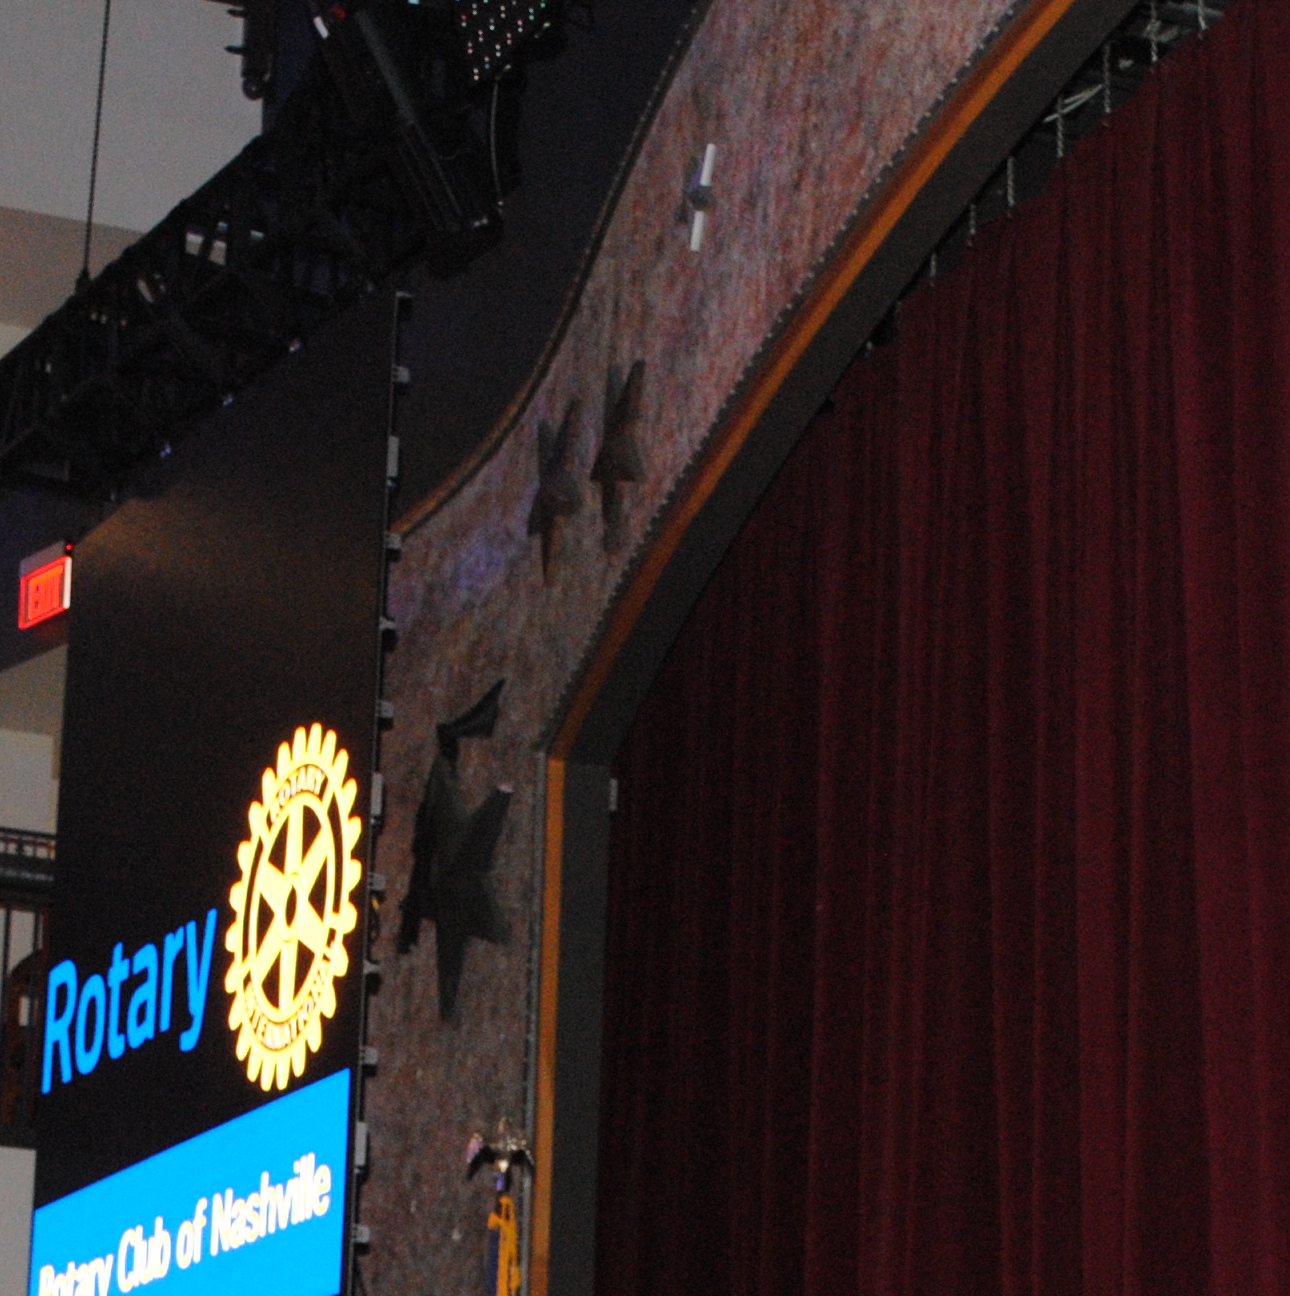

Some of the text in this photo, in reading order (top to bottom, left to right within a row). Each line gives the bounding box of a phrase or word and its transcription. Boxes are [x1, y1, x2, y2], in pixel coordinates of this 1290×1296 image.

[41, 908, 217, 1094] Rotary
[117, 1216, 171, 1292] Club
[176, 1197, 207, 1269] of
[210, 1152, 331, 1256] Nashville
